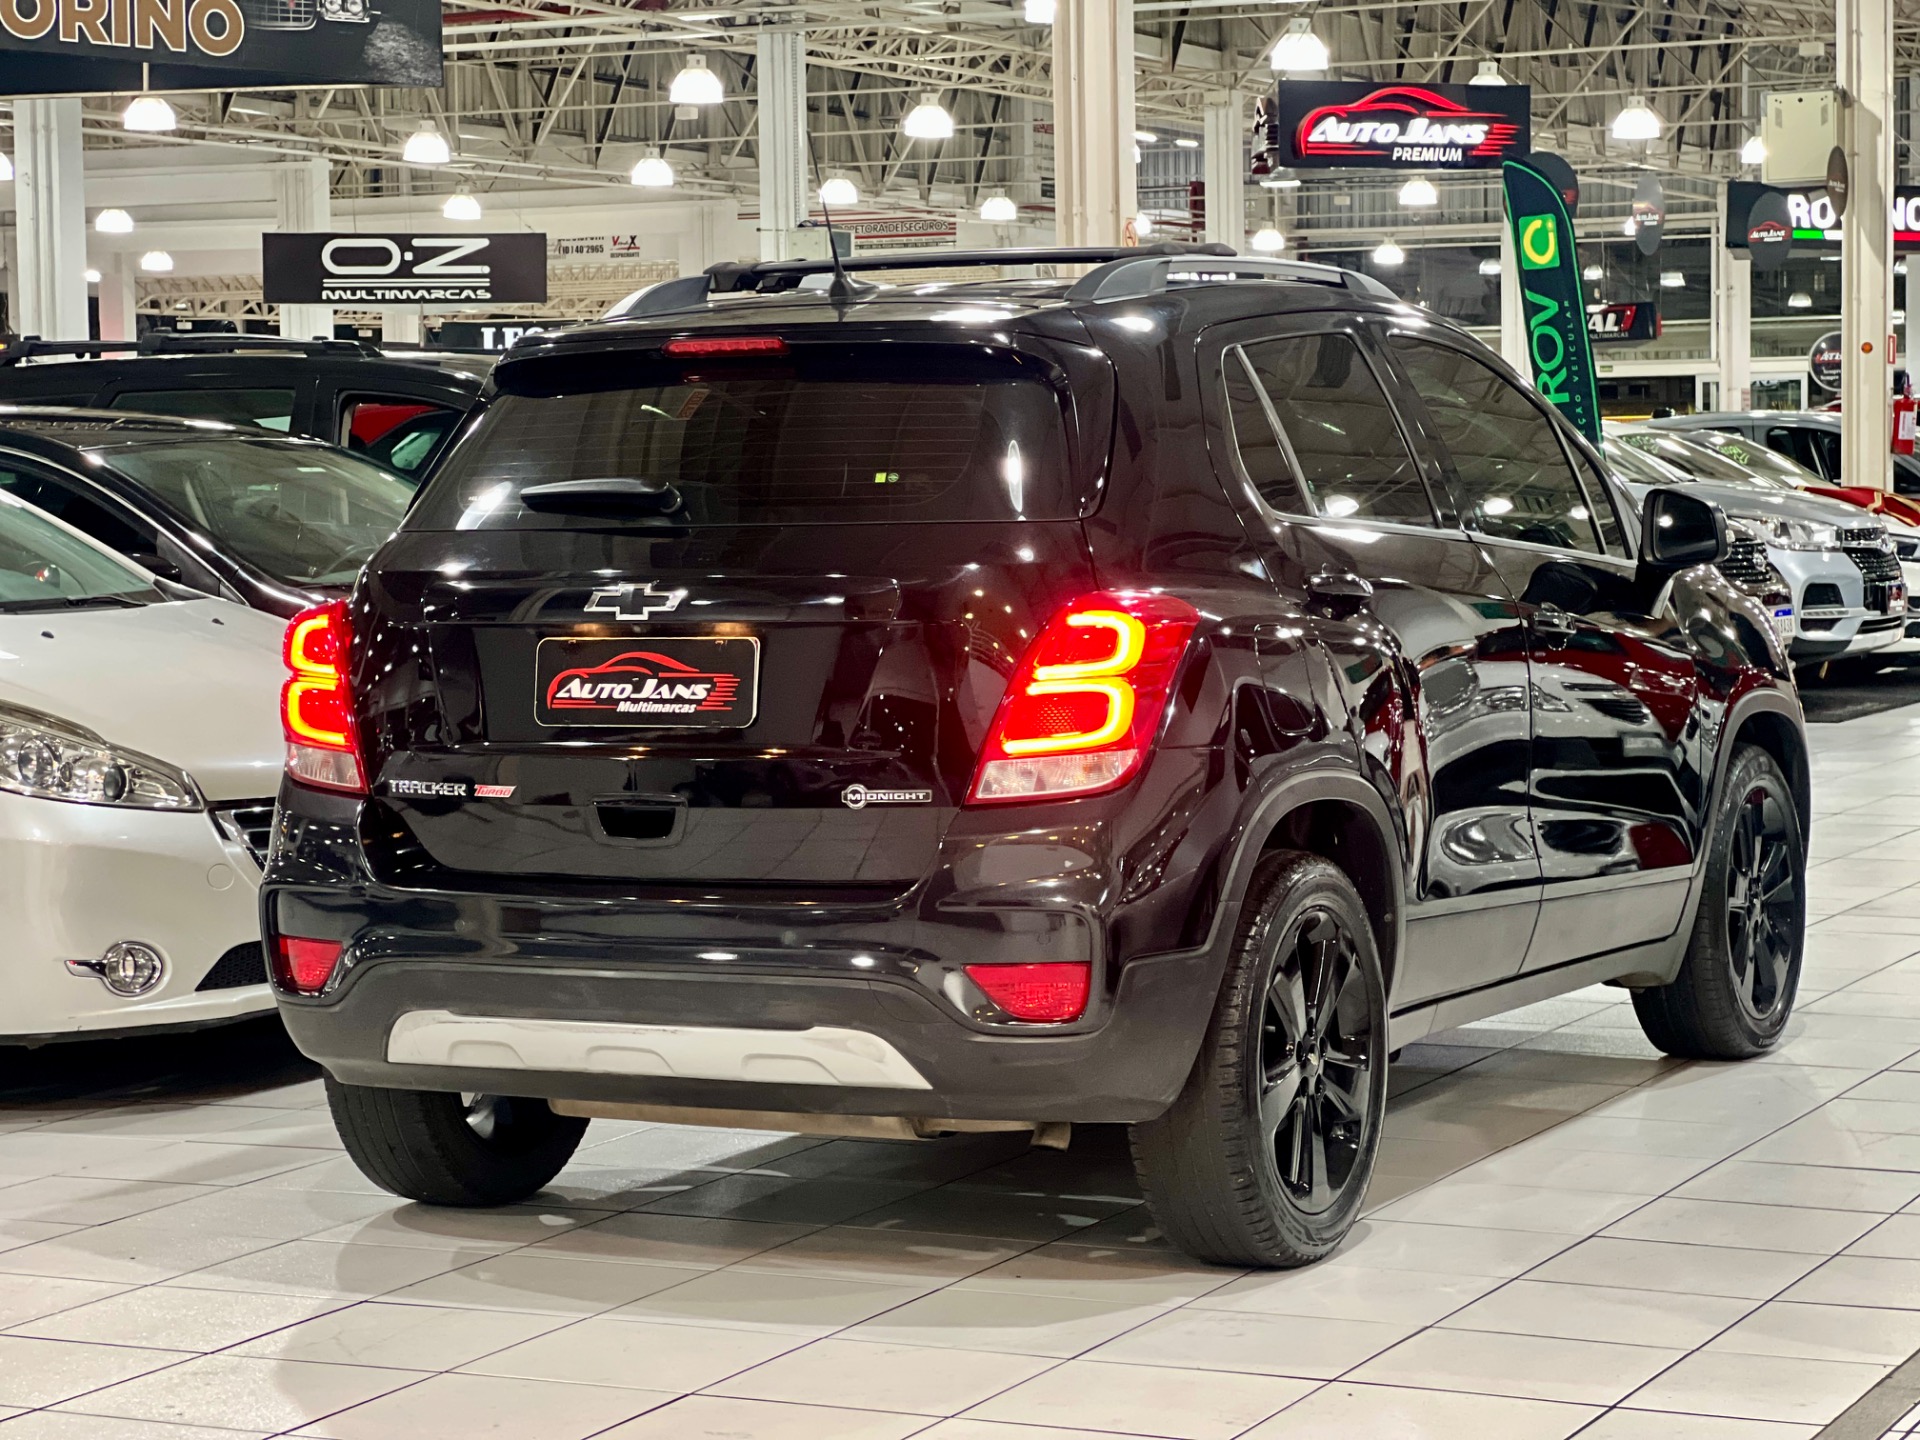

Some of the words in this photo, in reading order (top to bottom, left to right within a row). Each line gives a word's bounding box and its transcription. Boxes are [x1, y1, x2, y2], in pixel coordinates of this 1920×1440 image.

[1392, 147, 1463, 162] PREMIUM
[904, 221, 949, 232] SEGUROS
[321, 289, 492, 300] MULTIMARCAS
[1563, 300, 1580, 384] VEICULAR
[616, 701, 697, 713] Multimarcas
[389, 779, 467, 796] TRACKER
[847, 792, 926, 801] MIDNIGHT
